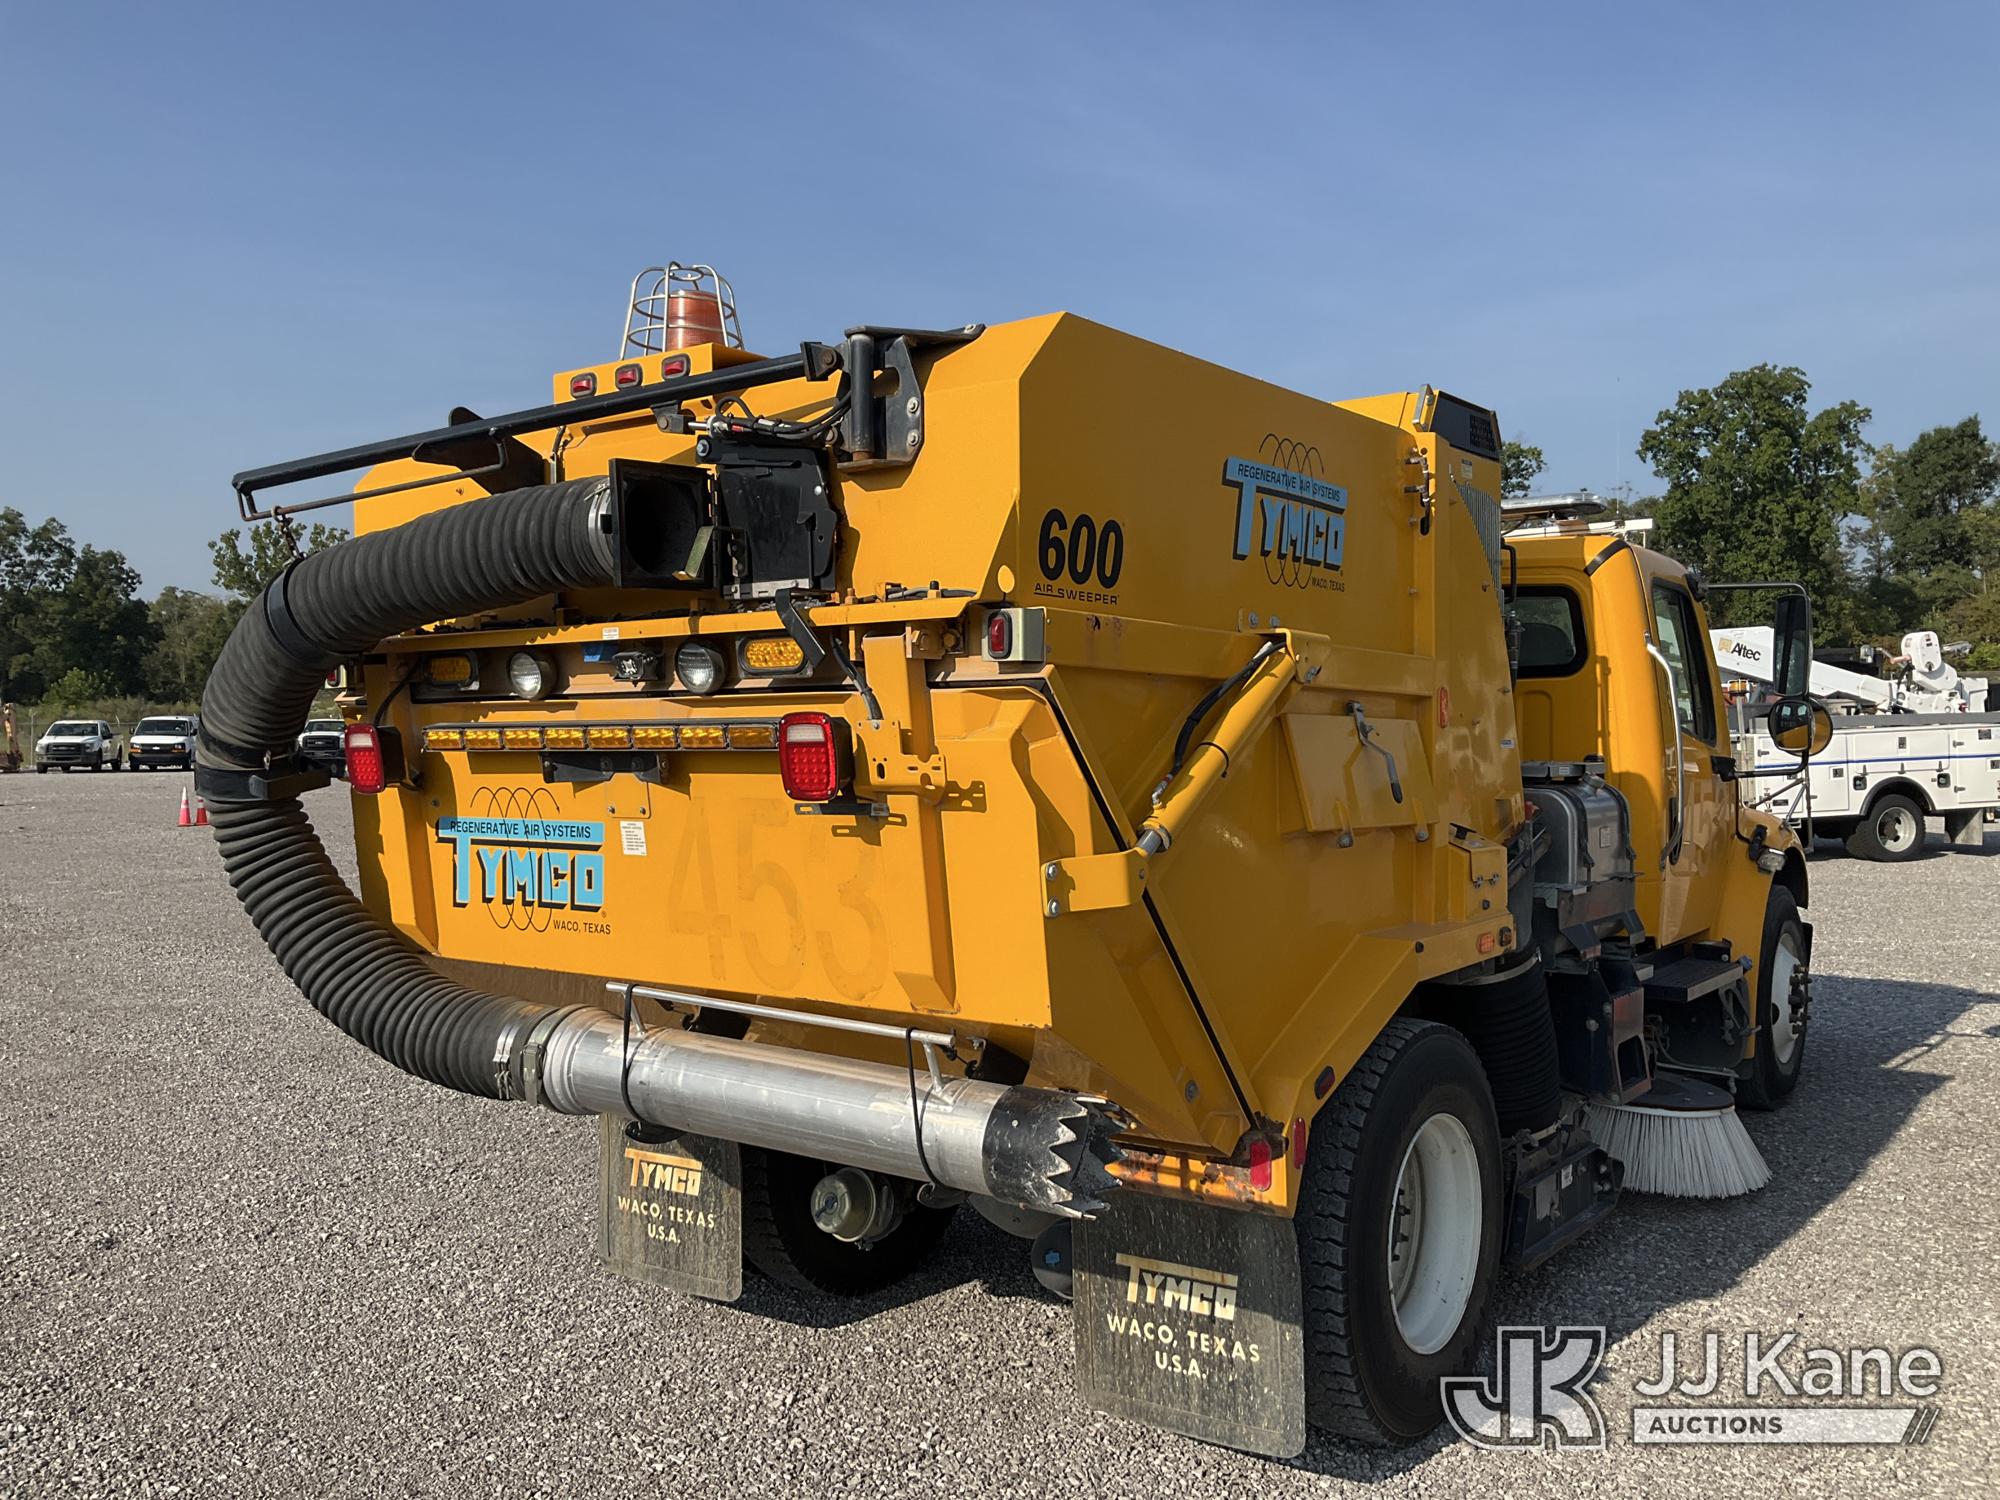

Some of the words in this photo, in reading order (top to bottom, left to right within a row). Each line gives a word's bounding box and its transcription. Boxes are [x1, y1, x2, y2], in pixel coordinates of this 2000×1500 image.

[1238, 463, 1297, 489] REGENERATIVE
[1298, 478, 1311, 493] AIR
[1312, 482, 1341, 502] SYSTEMS
[1221, 456, 1348, 571] TYMCO
[1039, 508, 1124, 589] 600
[1034, 583, 1053, 593] AIR
[1057, 587, 1117, 605] SWEEPER
[1731, 642, 1761, 661] Altec
[450, 820, 519, 835] REGENERATIVE
[523, 822, 540, 837] AIR
[544, 824, 591, 839] SYSTEMS
[435, 816, 605, 913] TYMCO
[552, 919, 581, 934] WACO,
[583, 921, 611, 935] TEXAS
[624, 1147, 703, 1197] TYMCO
[617, 1195, 663, 1221] WACO,
[668, 1205, 715, 1229] TEXAS
[647, 1223, 681, 1244] U.S.A.
[1115, 1252, 1239, 1321] TYMCO
[1106, 1312, 1178, 1348] WACO,
[1187, 1330, 1261, 1363] TEXAS
[1154, 1350, 1208, 1379] U.S.A.
